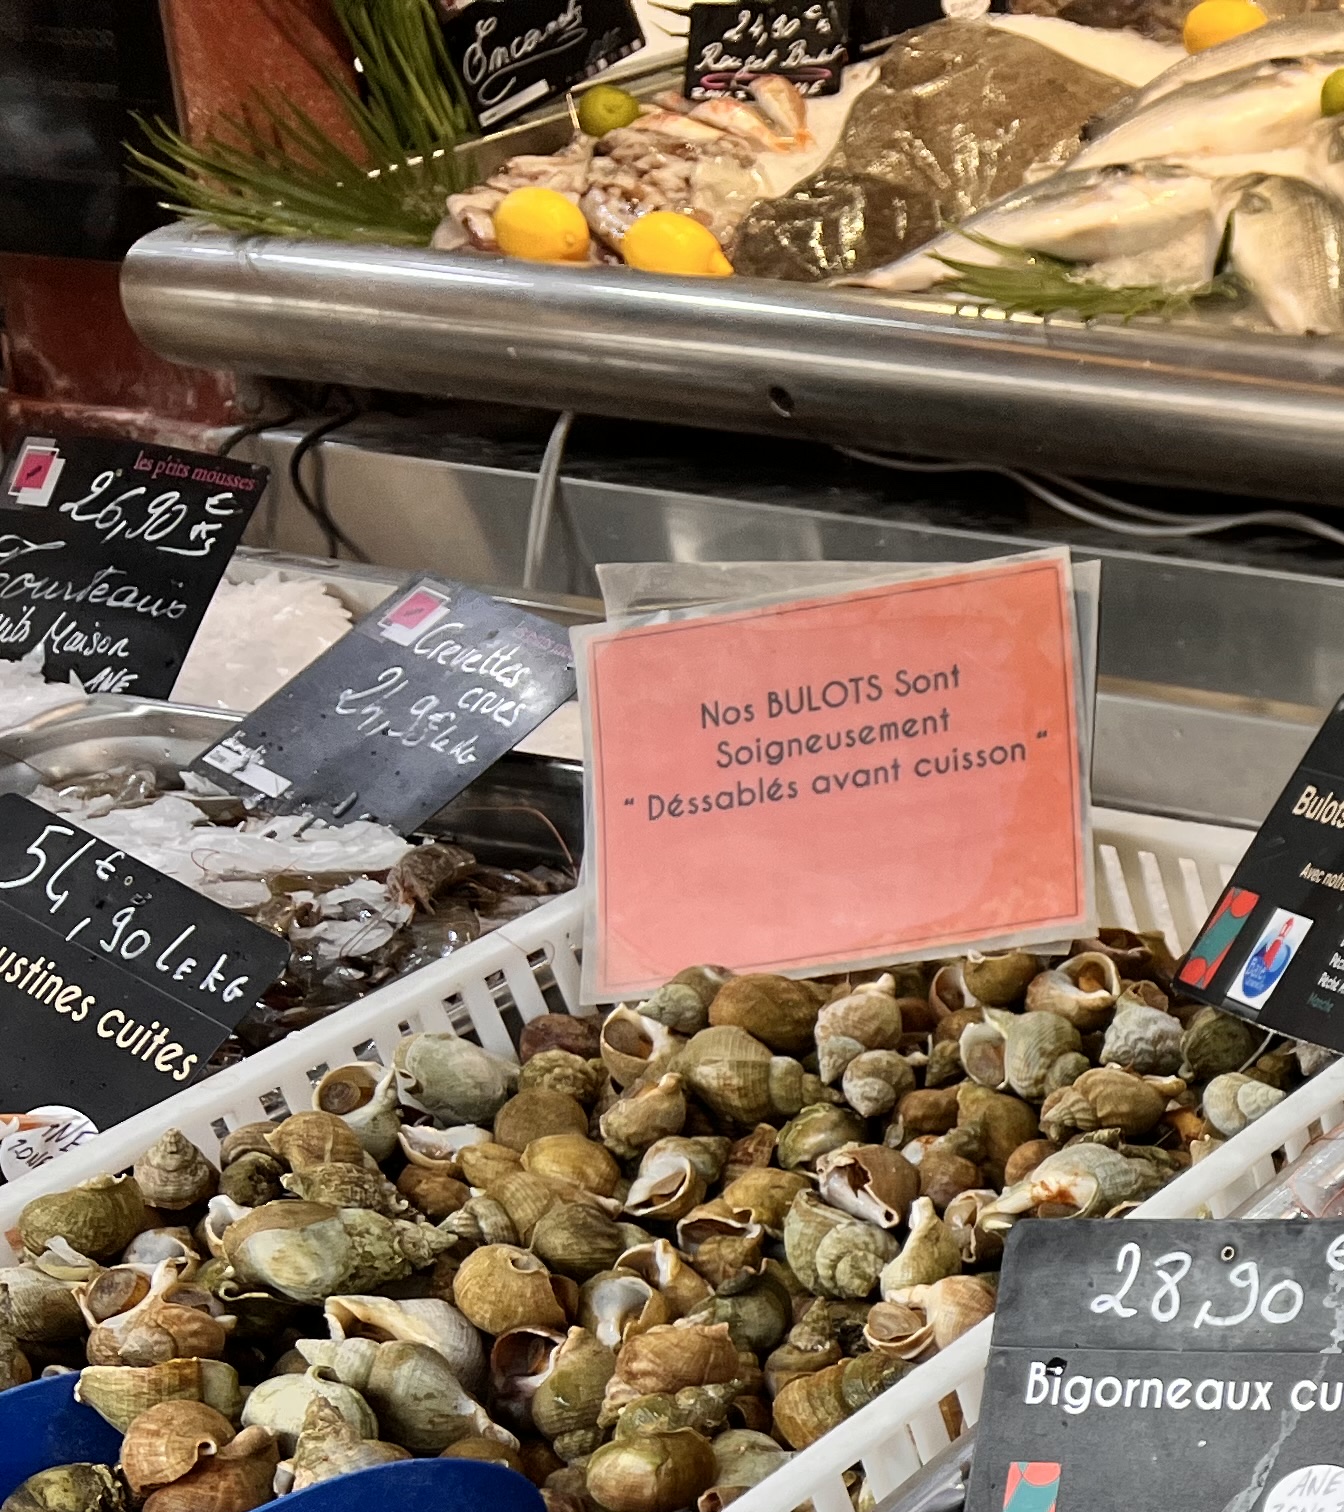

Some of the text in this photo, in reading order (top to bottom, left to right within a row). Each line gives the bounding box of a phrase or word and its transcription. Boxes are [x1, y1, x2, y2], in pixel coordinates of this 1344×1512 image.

[59, 470, 189, 544] 26,90
[192, 466, 257, 491] mousses
[414, 622, 531, 688] Crevettes
[701, 664, 961, 730] Nos BULOTS Sont
[715, 707, 951, 769] Soigneusement
[647, 777, 799, 822] Déssablés
[811, 758, 902, 795] avant
[913, 741, 1027, 779] cuisson
[1299, 862, 1326, 884] Avec
[97, 1009, 199, 1082] cuites
[1090, 1241, 1305, 1329] 28,90
[1025, 1361, 1274, 1415] Bigorneaux
